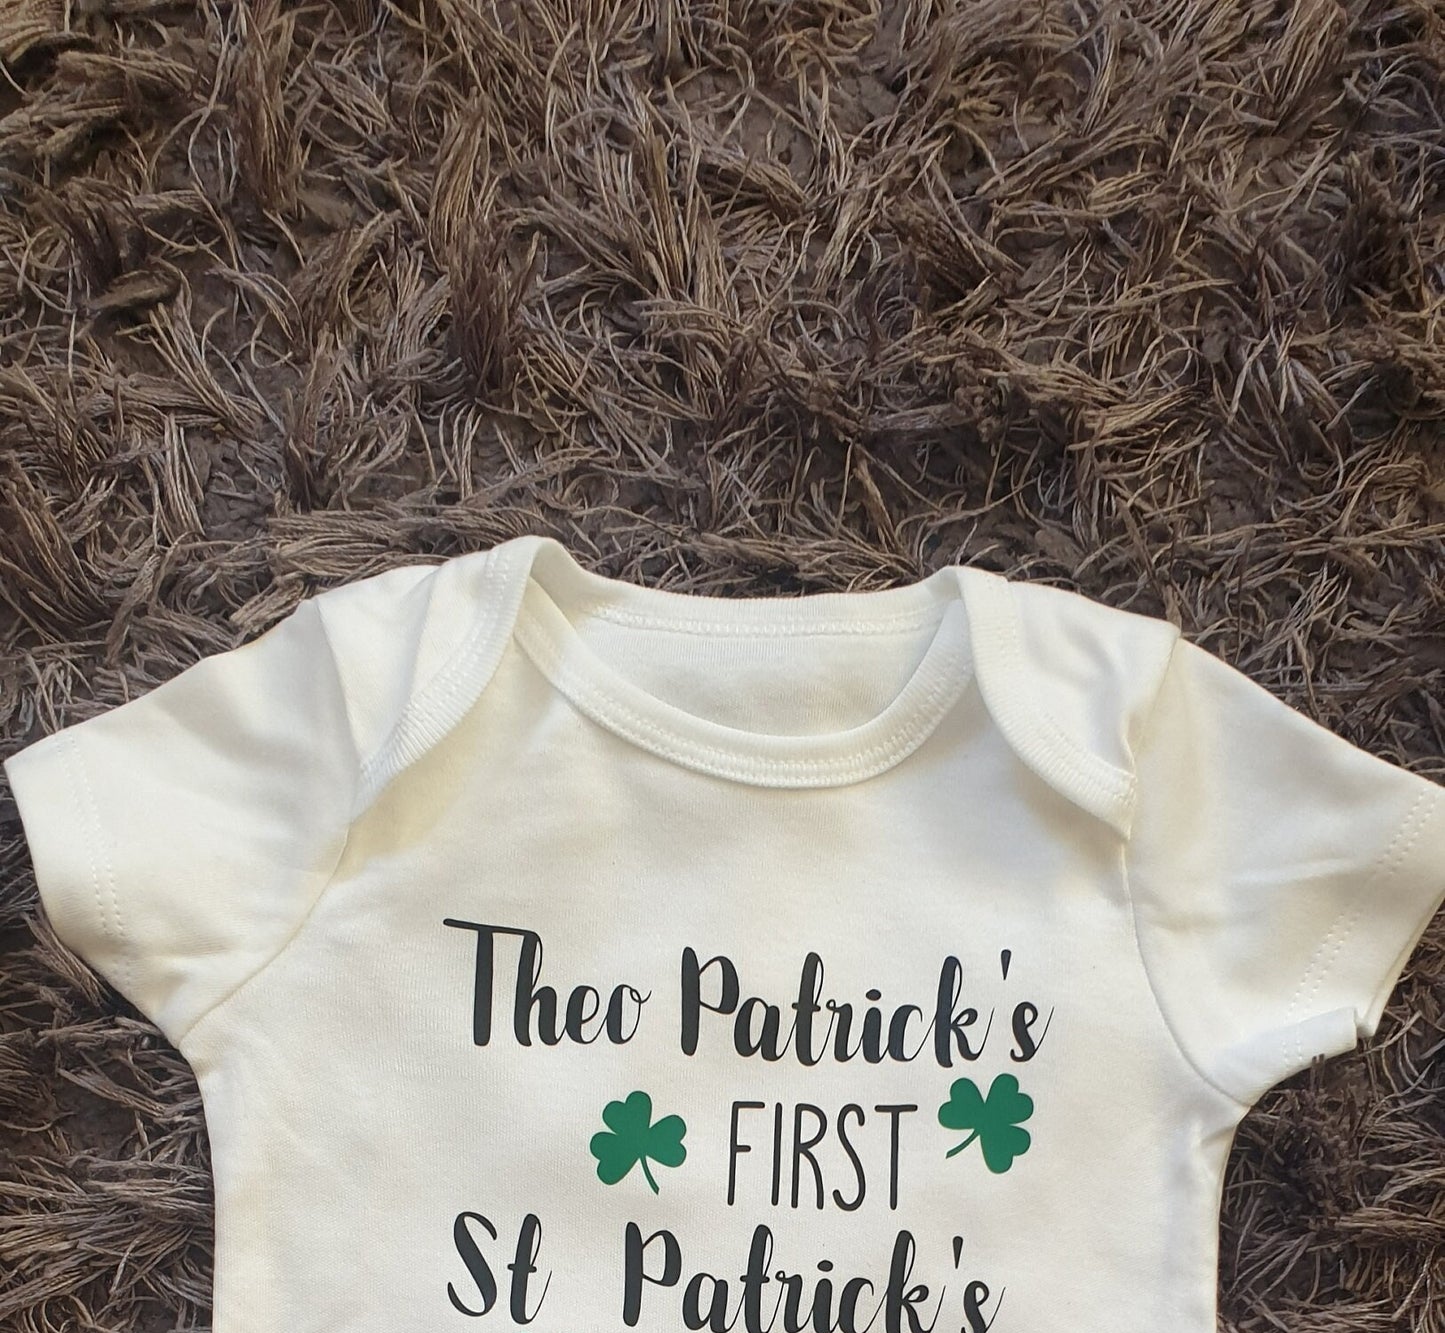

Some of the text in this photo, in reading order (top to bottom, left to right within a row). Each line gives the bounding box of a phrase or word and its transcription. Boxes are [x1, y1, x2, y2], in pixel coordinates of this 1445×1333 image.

[442, 918, 1055, 1069] Theo Patrick's
[726, 1100, 919, 1212] FIRST
[447, 1211, 553, 1325] St
